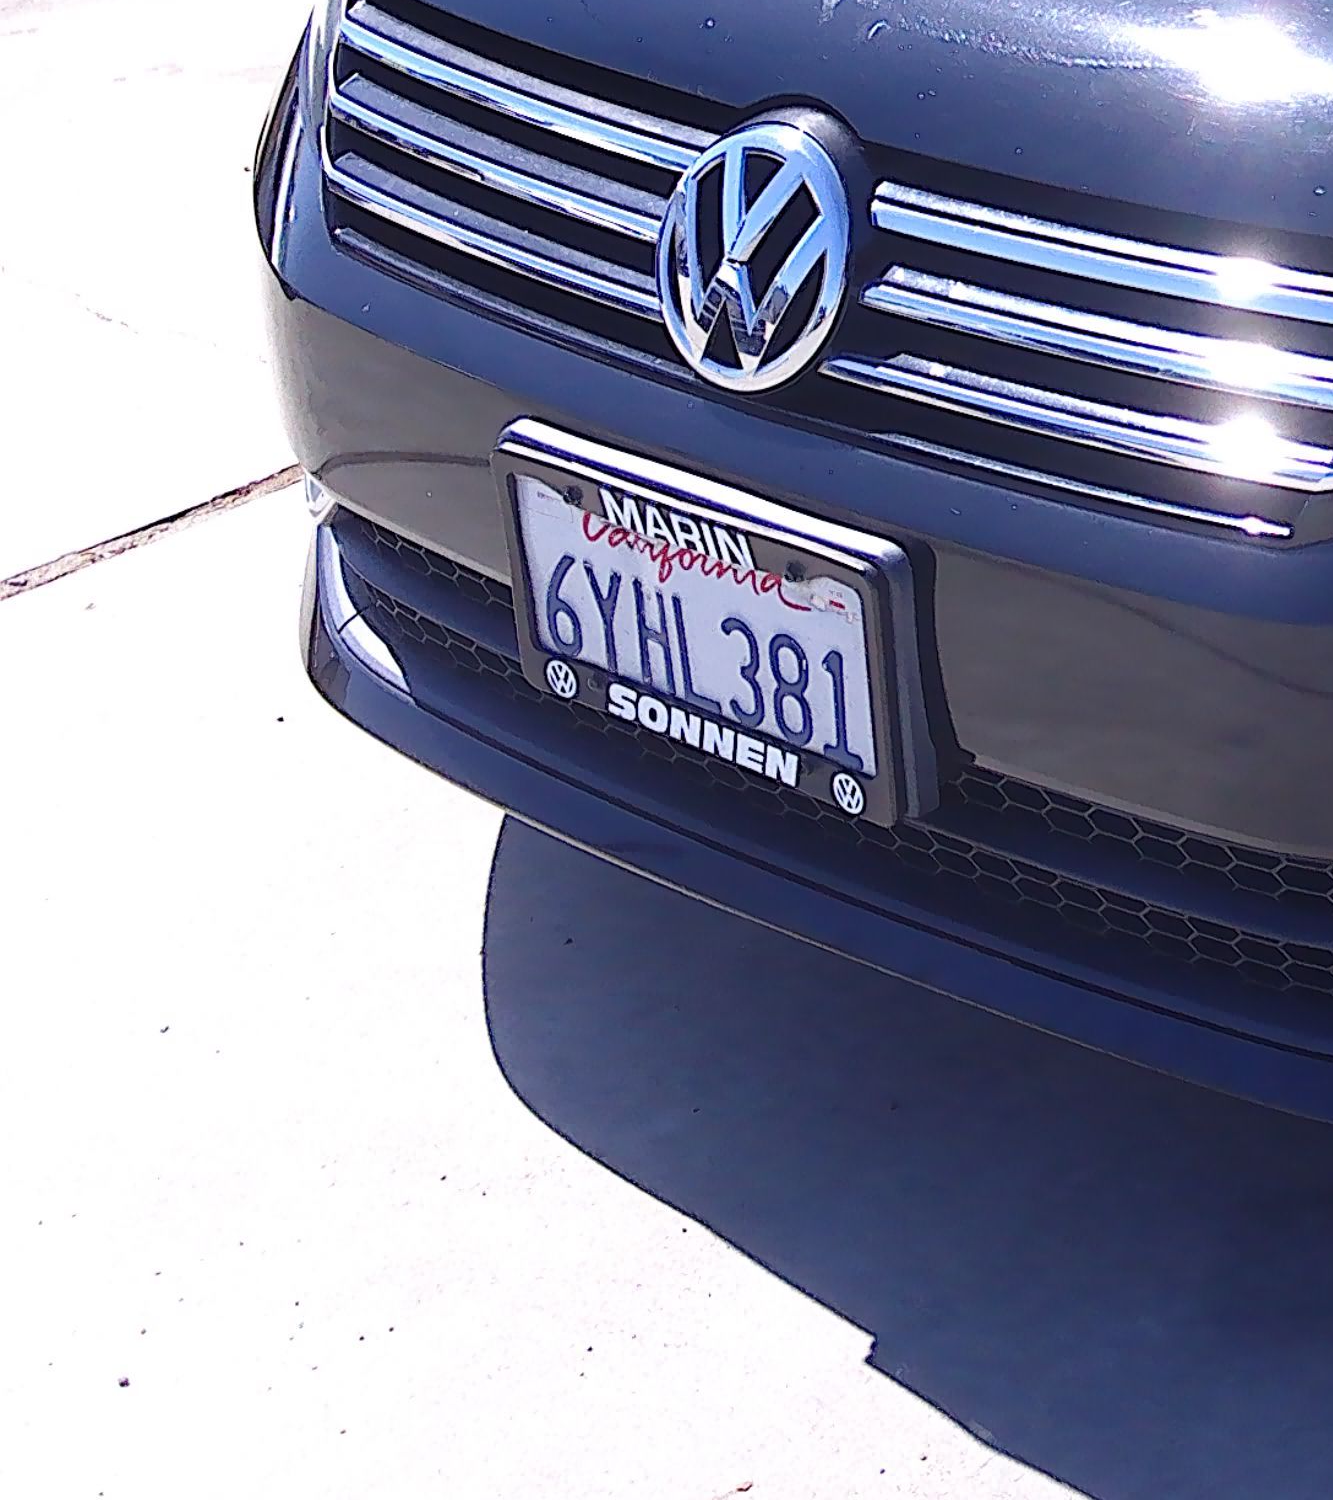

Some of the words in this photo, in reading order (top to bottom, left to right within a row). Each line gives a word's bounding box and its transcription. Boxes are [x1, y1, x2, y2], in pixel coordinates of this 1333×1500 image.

[600, 486, 756, 570] MARIN
[545, 554, 863, 770] 6YHL381
[607, 682, 799, 787] SONNEN
